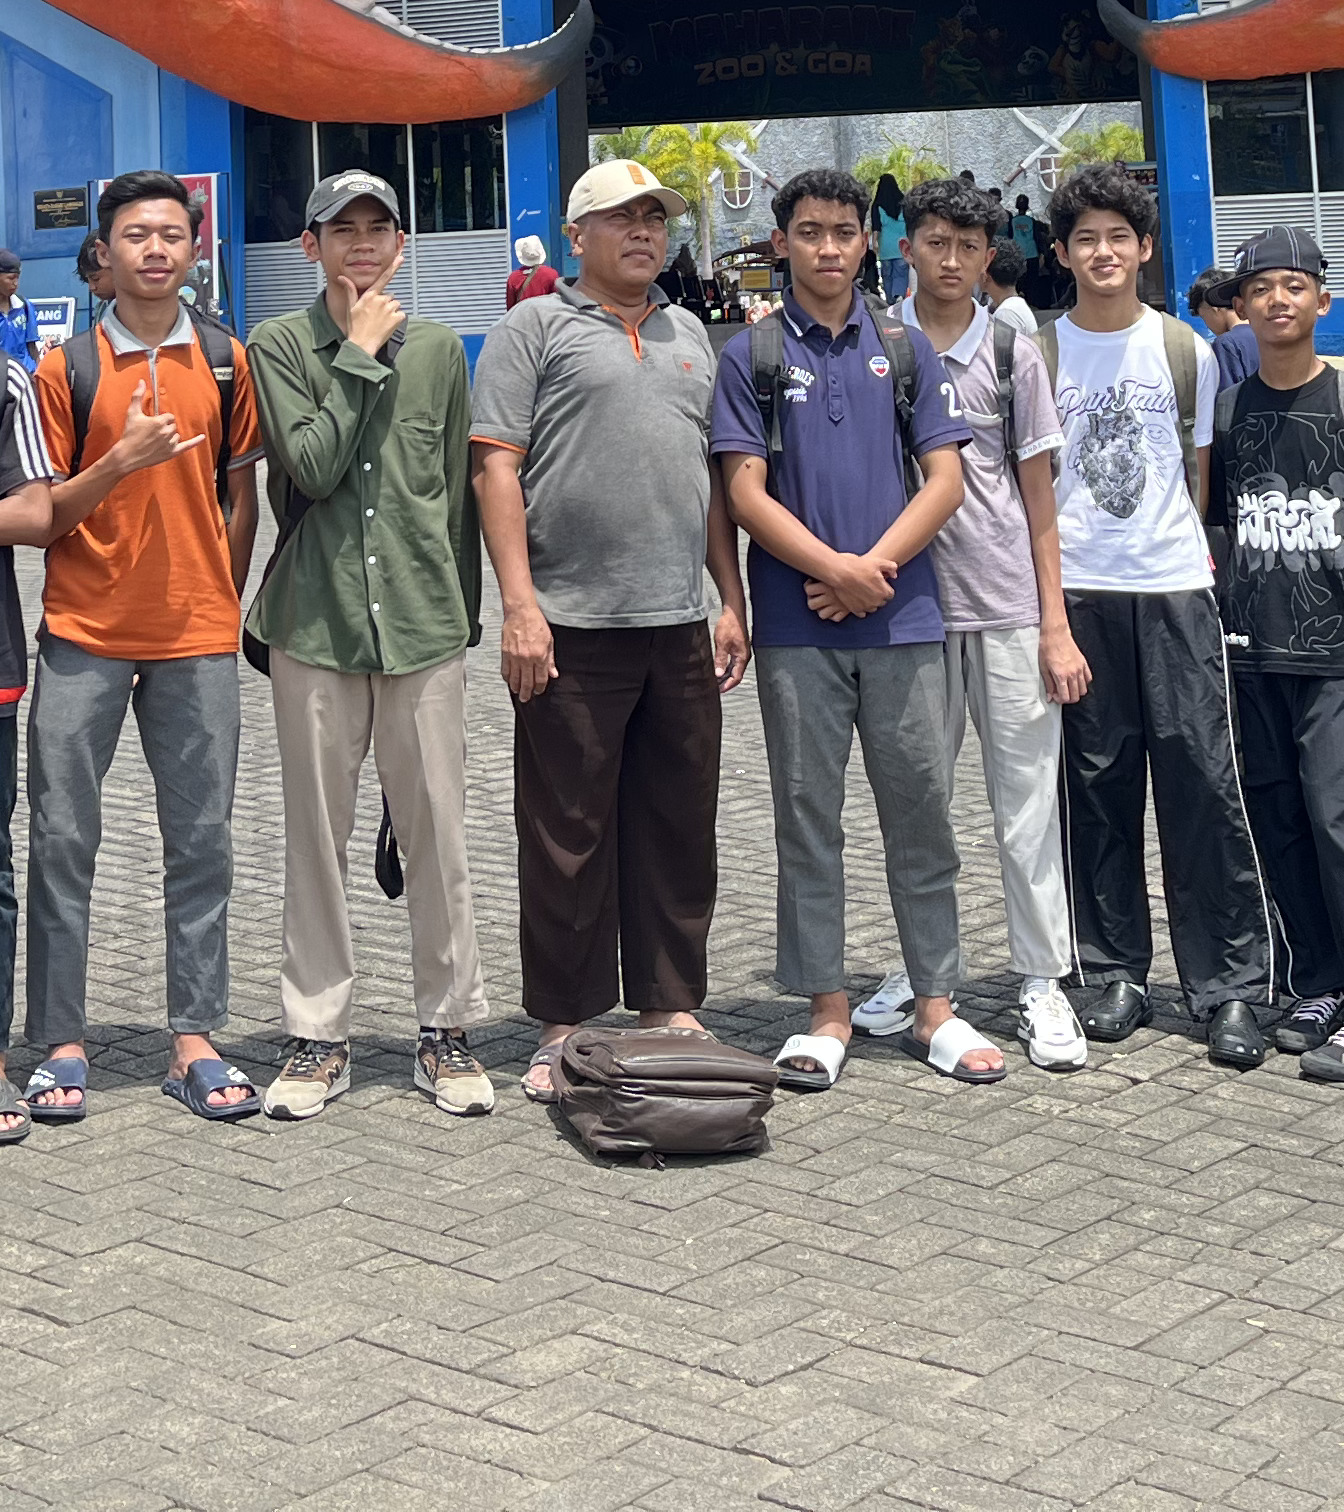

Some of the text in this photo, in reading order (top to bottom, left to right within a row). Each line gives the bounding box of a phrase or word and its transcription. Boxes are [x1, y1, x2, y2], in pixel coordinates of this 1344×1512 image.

[695, 51, 873, 86] ZOO & GOA
[34, 309, 62, 321] ANG
